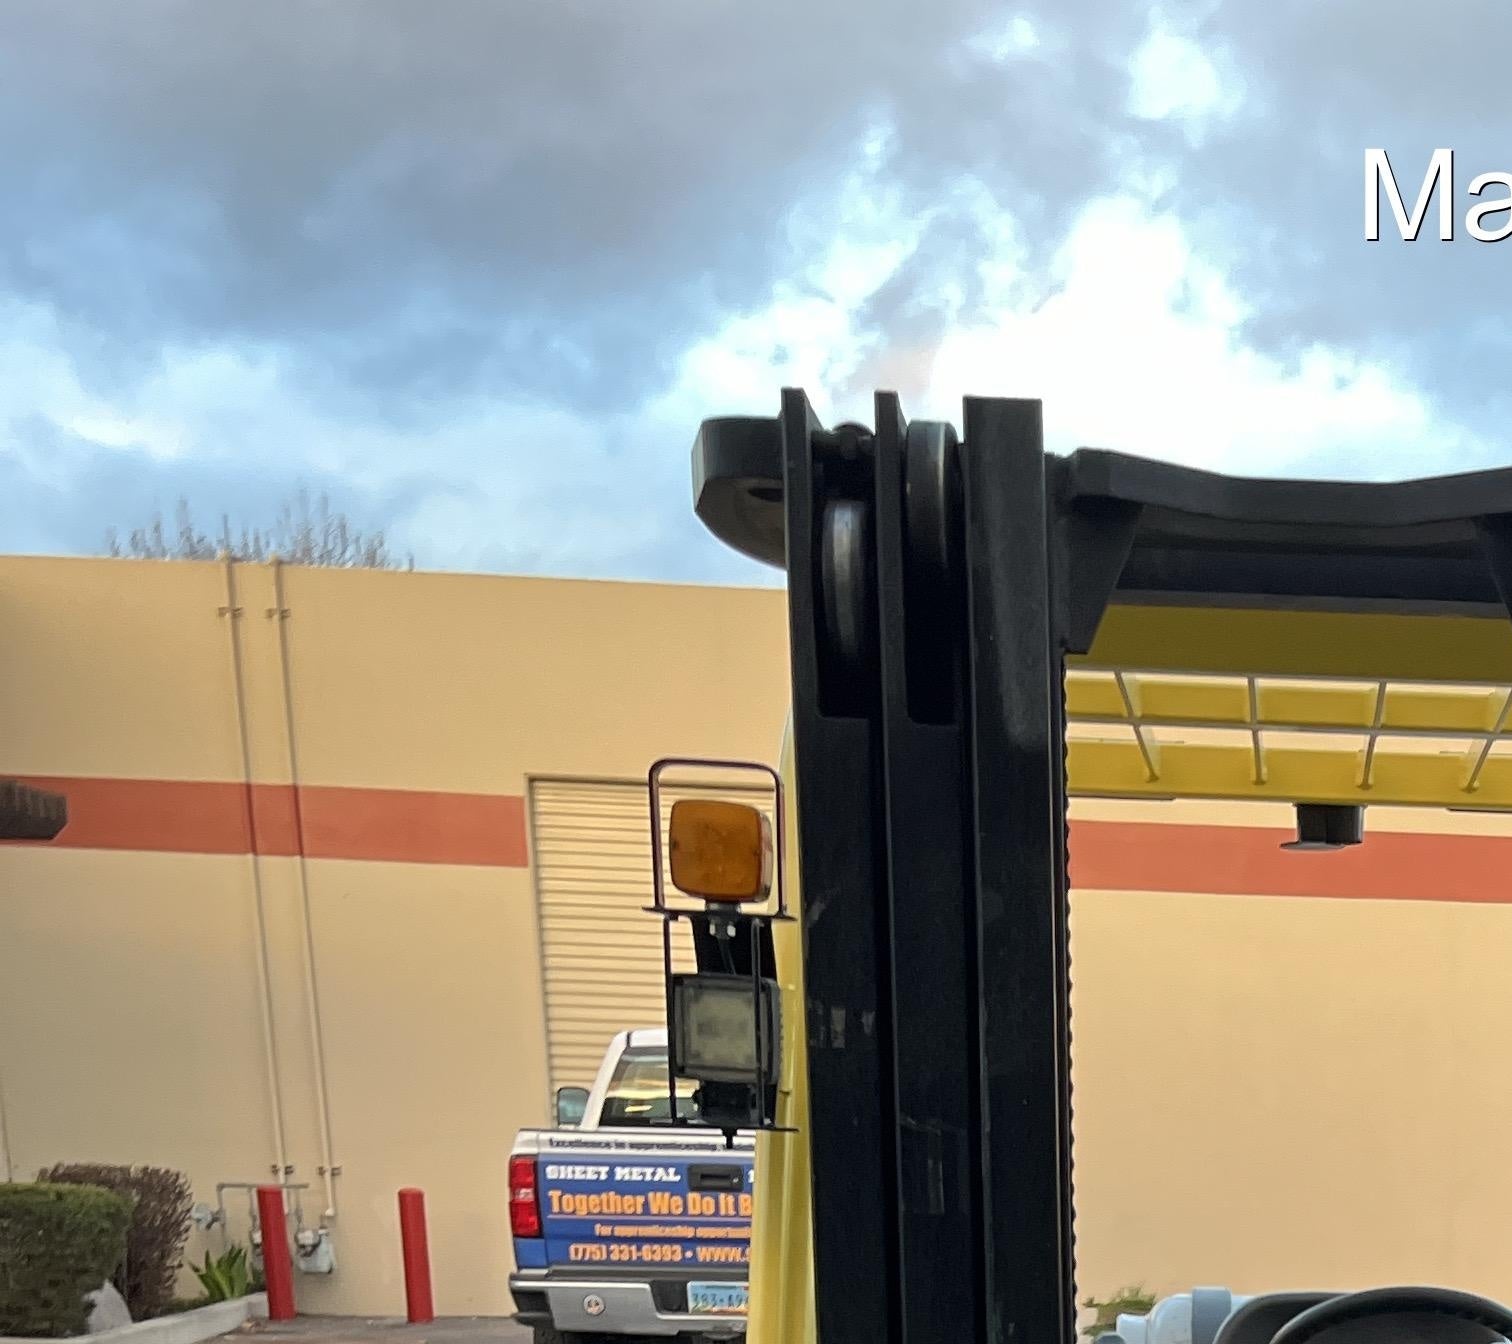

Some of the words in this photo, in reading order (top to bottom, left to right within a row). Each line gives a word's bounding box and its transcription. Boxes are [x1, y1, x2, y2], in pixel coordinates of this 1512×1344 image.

[545, 1165, 610, 1180] SHEET
[614, 1166, 681, 1182] METAL
[548, 1190, 645, 1216] Together
[648, 1191, 683, 1215] We
[687, 1192, 715, 1216] Do
[719, 1193, 735, 1216] It
[569, 1243, 607, 1261] (775)
